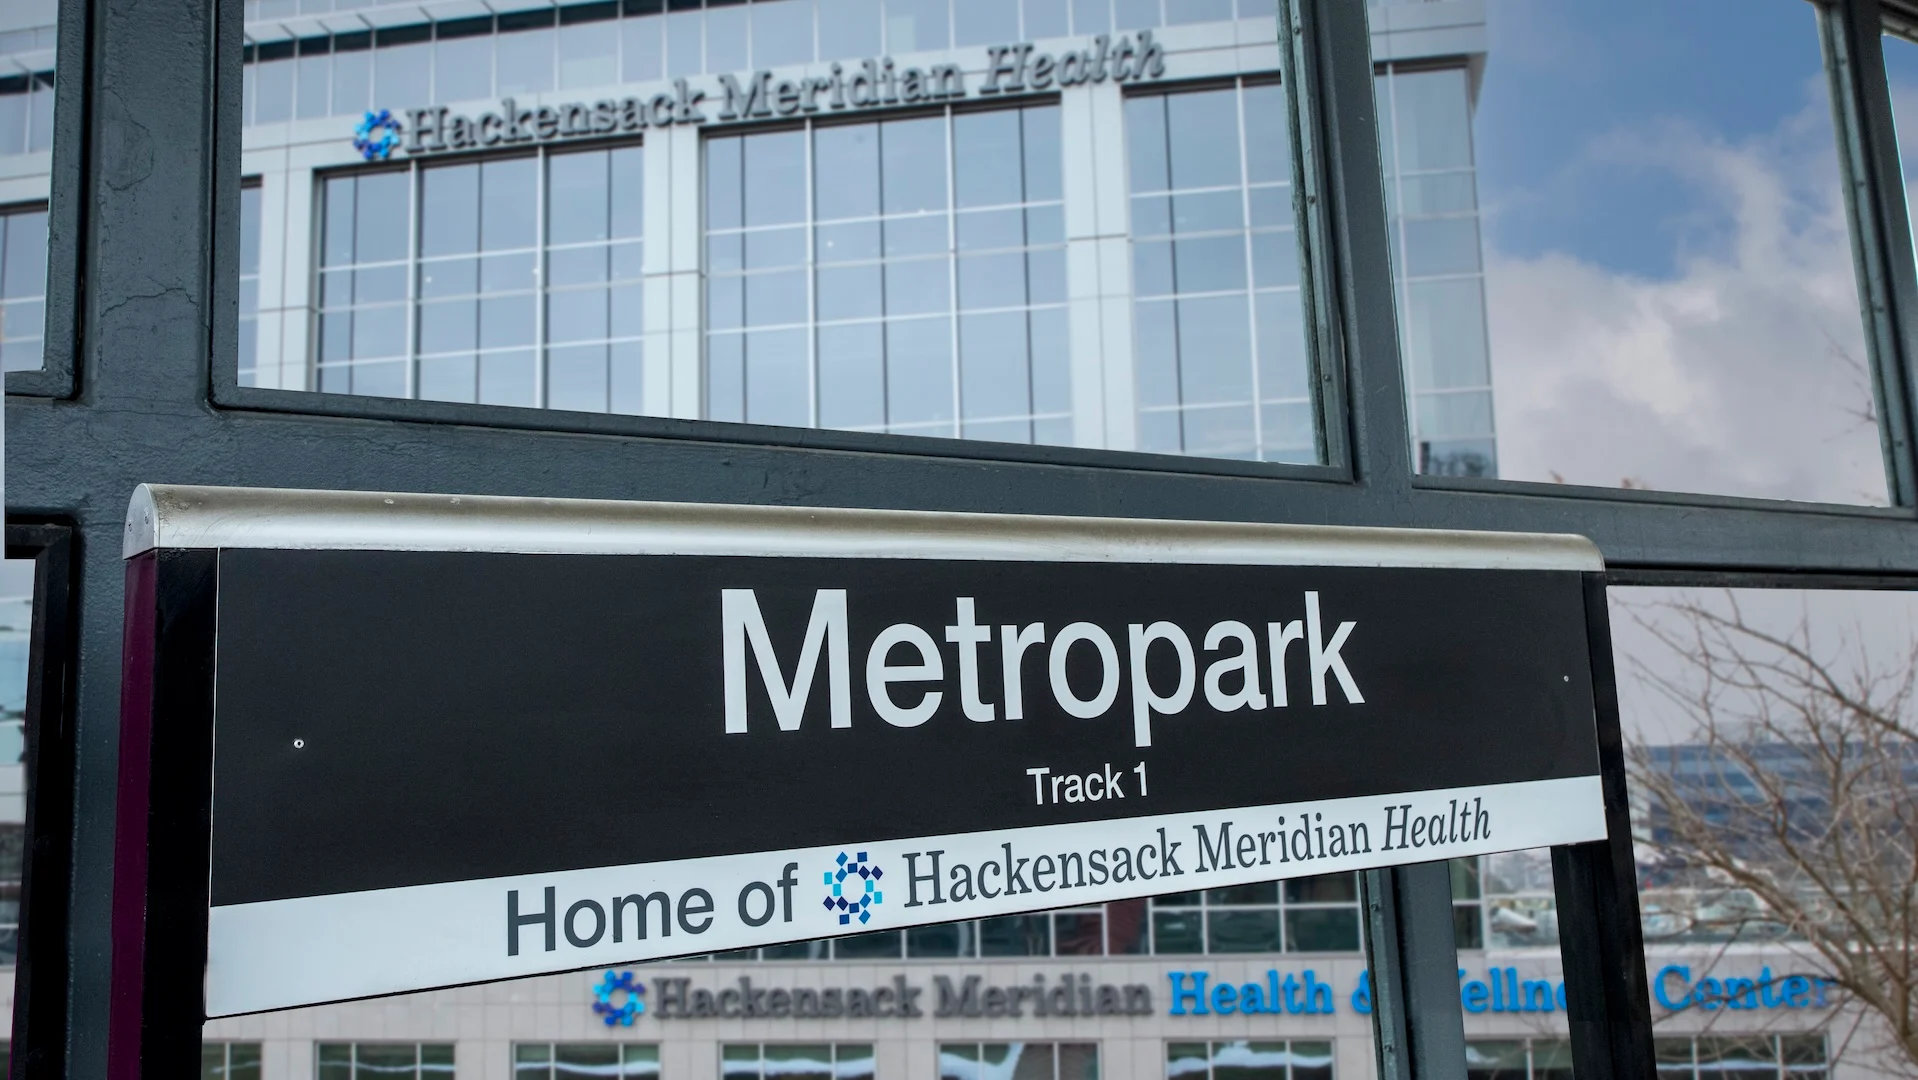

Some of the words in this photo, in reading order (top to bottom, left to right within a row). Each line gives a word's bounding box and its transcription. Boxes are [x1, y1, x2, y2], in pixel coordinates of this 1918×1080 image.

[405, 77, 706, 153] Hackensack
[718, 57, 966, 121] Meridian
[979, 30, 1166, 93] Health
[722, 588, 1366, 748] Metropark
[1026, 763, 1125, 805] Track
[1133, 761, 1149, 797] 1
[507, 886, 715, 957] Home
[737, 862, 799, 928] of
[902, 827, 1185, 908] Hackensack
[1193, 812, 1372, 873] Meridian
[1381, 796, 1491, 851] Health
[652, 974, 923, 1020] Hackensack
[933, 973, 1154, 1018] Meridian
[1168, 969, 1335, 1016] Health
[1654, 963, 1837, 1011] Center
